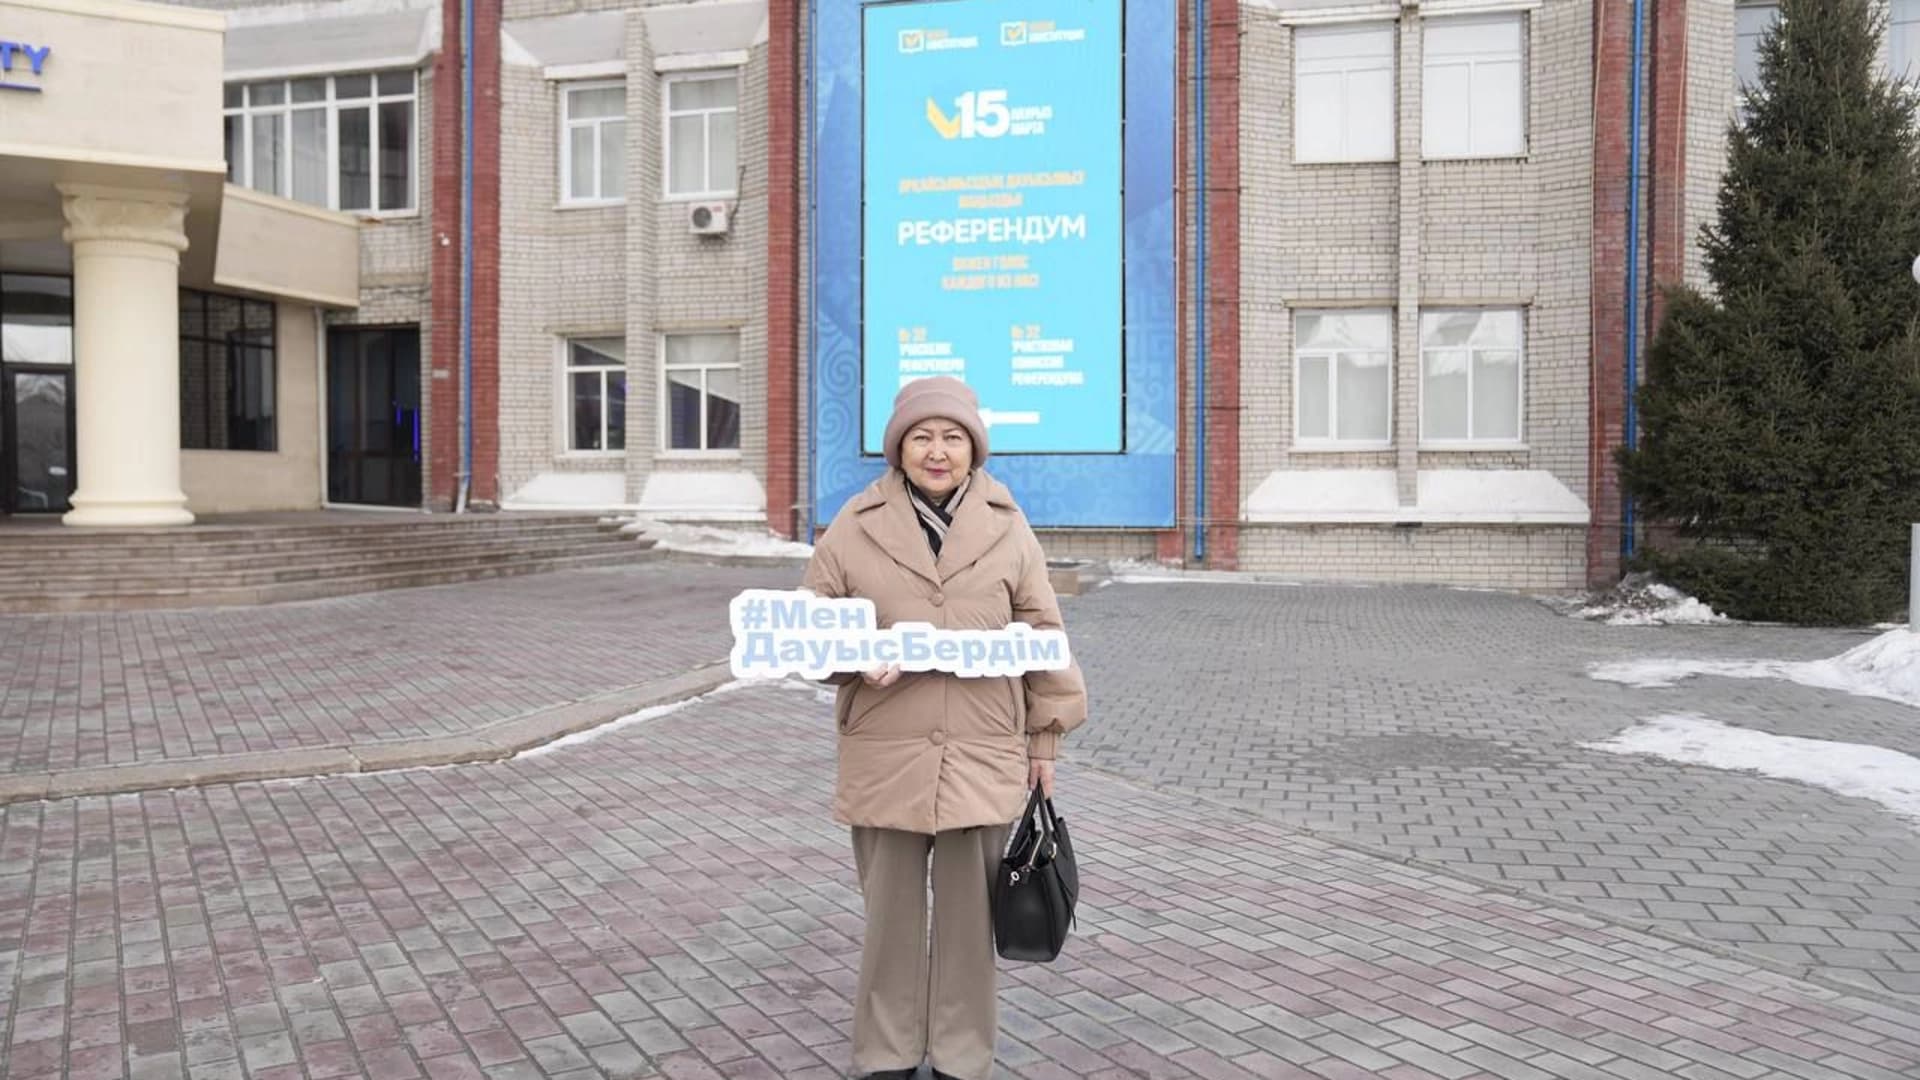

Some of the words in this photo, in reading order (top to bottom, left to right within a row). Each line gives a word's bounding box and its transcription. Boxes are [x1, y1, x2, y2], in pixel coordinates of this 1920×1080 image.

[955, 90, 1010, 139] 15
[898, 214, 1086, 245] РЕФЕРЕНДУМ
[741, 598, 867, 630] #Мен
[741, 631, 1062, 670] ДауысБердім
